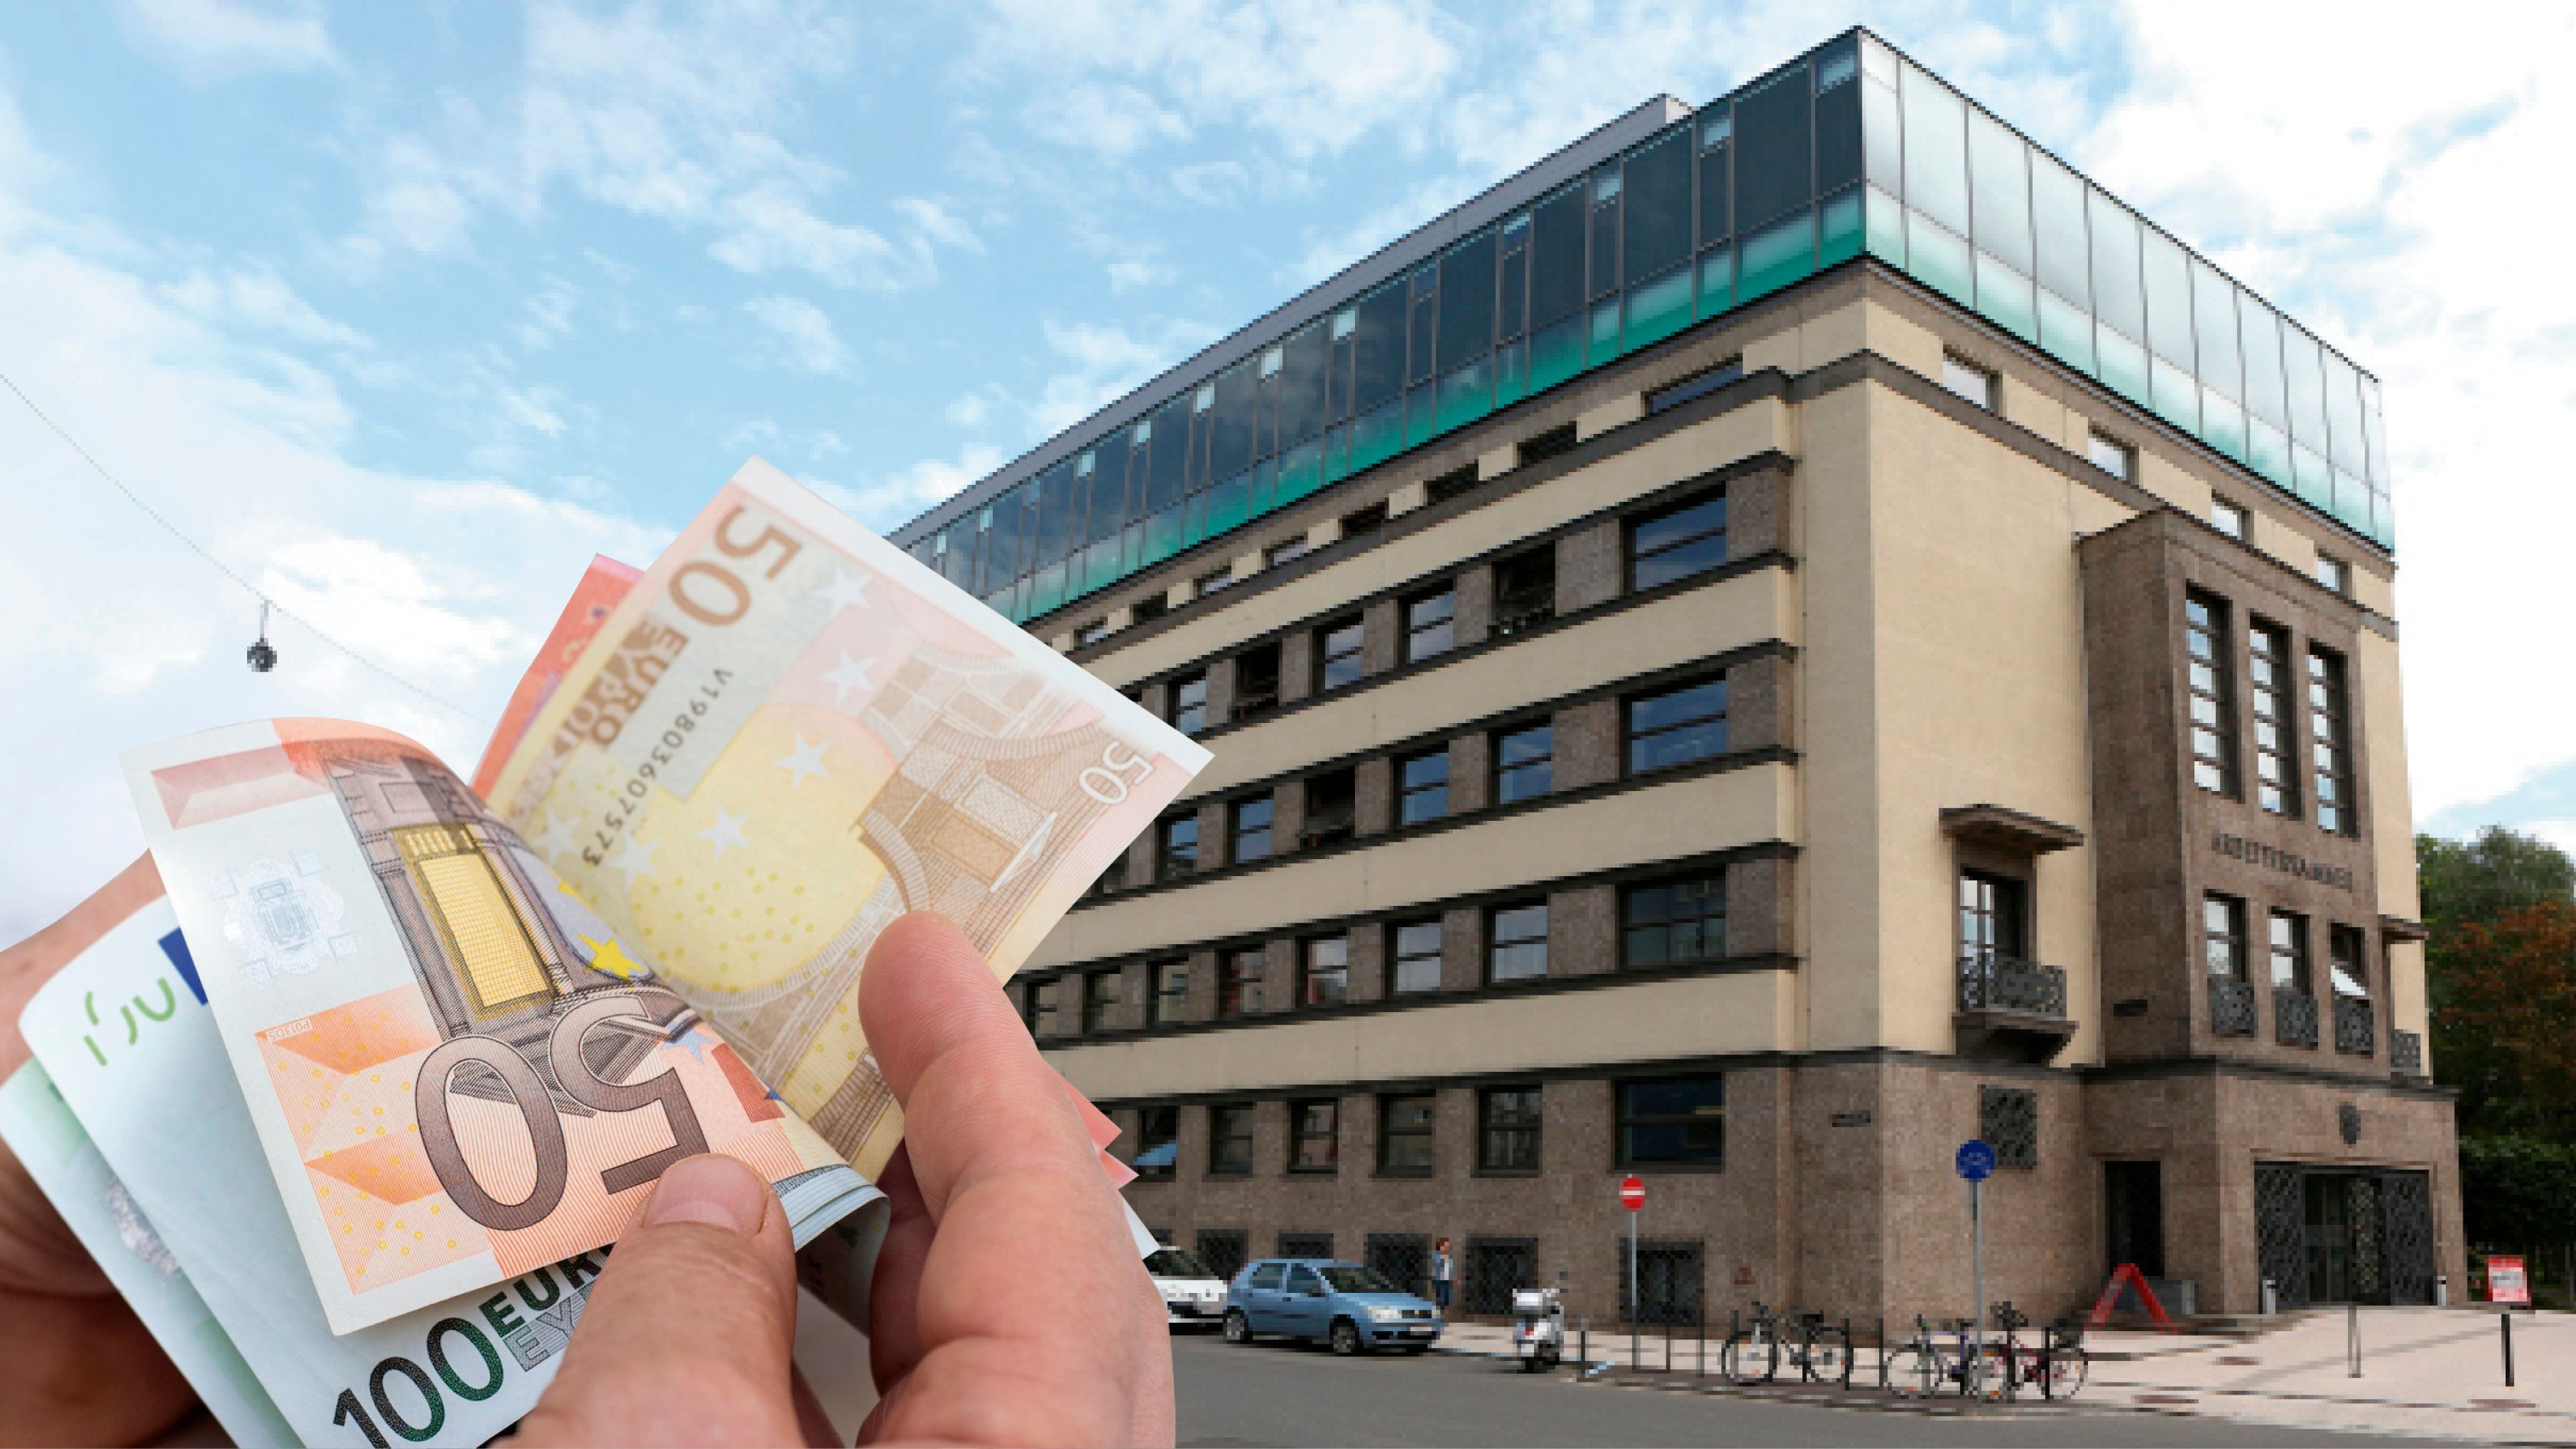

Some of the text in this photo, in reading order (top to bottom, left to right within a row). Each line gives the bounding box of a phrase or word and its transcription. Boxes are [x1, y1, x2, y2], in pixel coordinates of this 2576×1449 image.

[589, 504, 802, 748] 50 EURO
[581, 667, 734, 867] V19803607573
[1078, 740, 1154, 805] 50
[415, 994, 711, 1232] 50
[333, 1242, 614, 1449] 100 EUR
